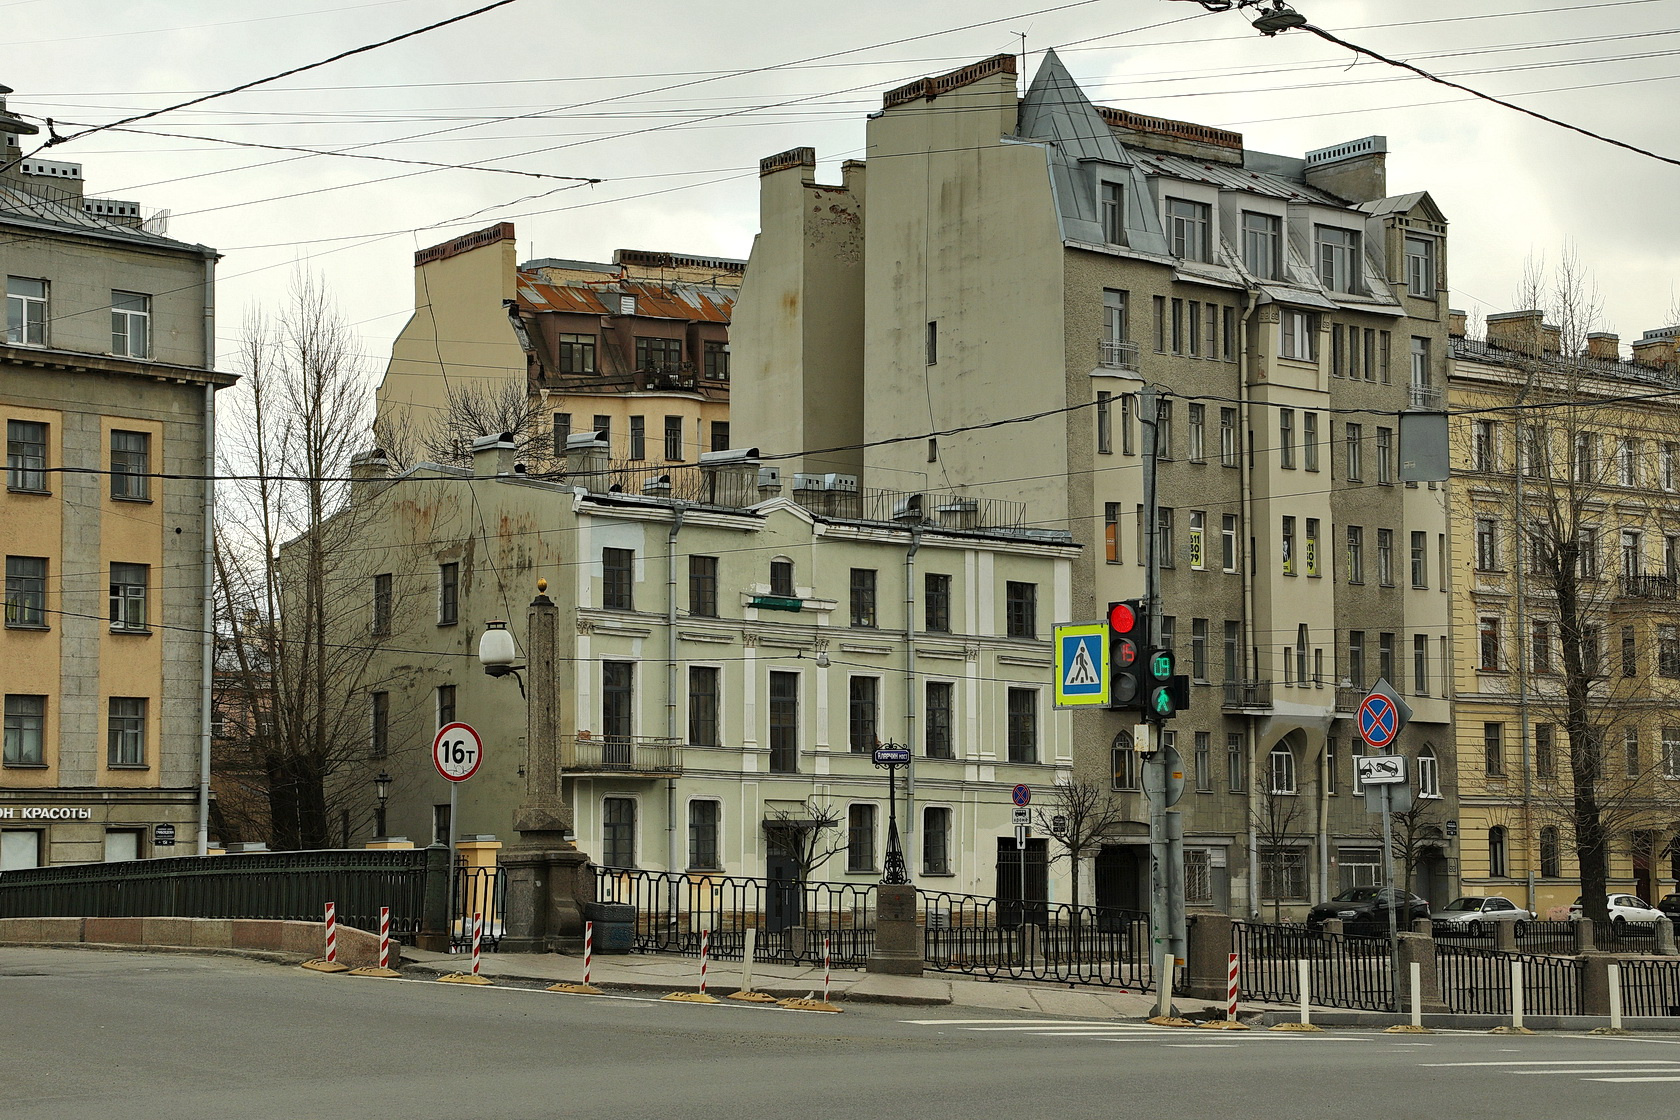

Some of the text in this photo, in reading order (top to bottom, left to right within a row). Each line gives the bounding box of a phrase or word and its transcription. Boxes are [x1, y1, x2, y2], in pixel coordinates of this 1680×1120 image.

[1122, 643, 1135, 662] 15
[1153, 657, 1171, 676] 09
[22, 808, 92, 819] КРАСОТЫ
